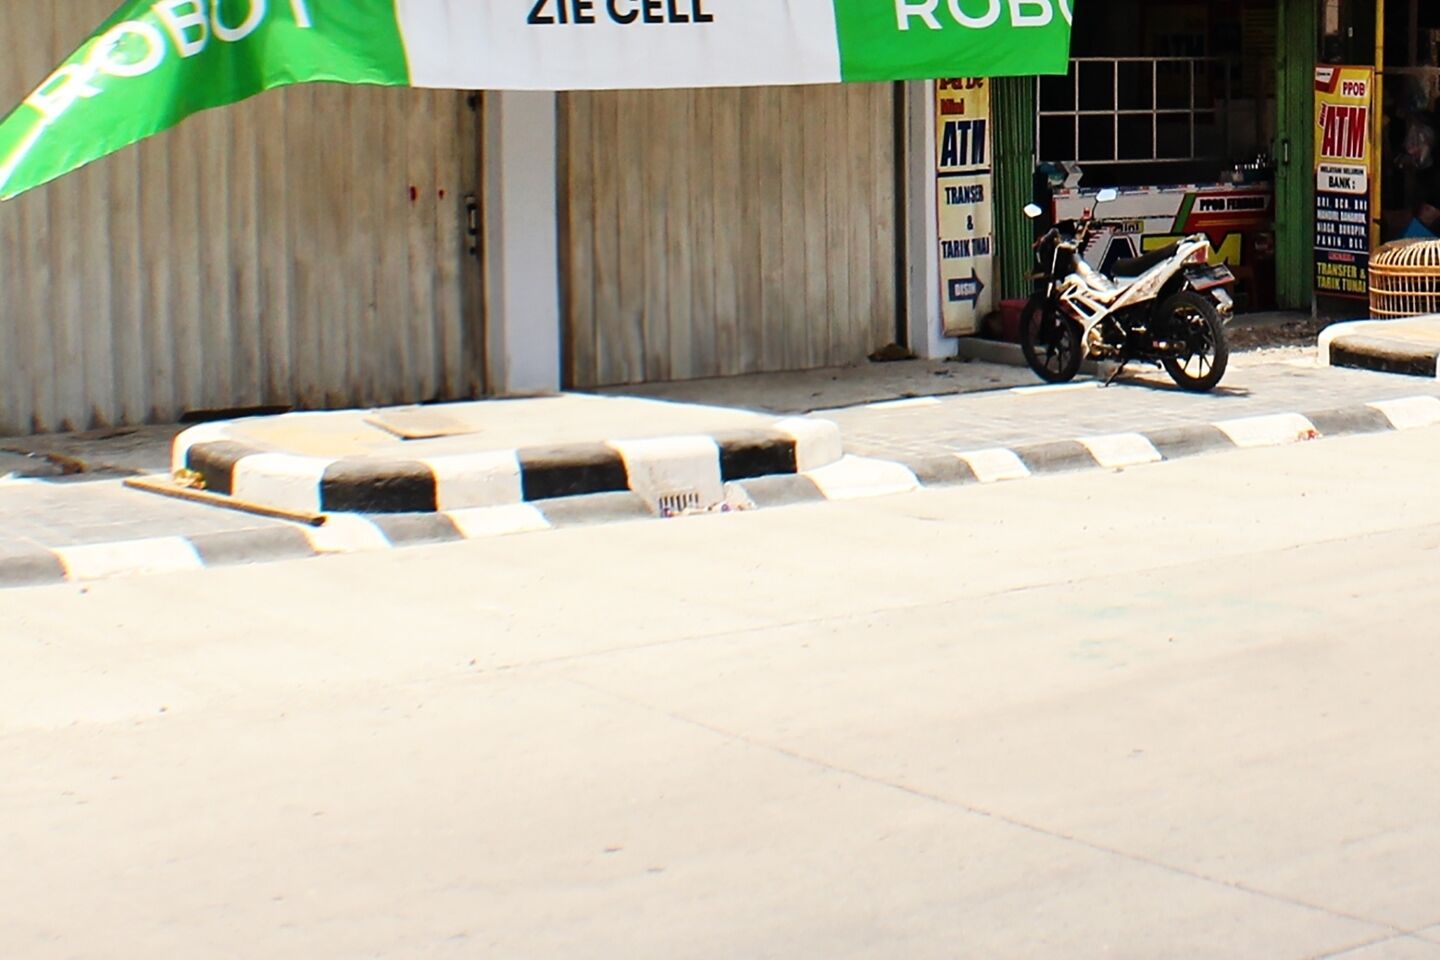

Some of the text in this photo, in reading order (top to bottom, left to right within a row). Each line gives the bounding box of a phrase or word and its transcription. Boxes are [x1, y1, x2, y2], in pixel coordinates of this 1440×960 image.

[1342, 81, 1366, 96] PPOB
[1321, 105, 1367, 158] ATM
[1328, 176, 1351, 189] BANK
[967, 214, 974, 231] &
[941, 240, 969, 259] TARIK
[1317, 262, 1358, 280] TRANSFER
